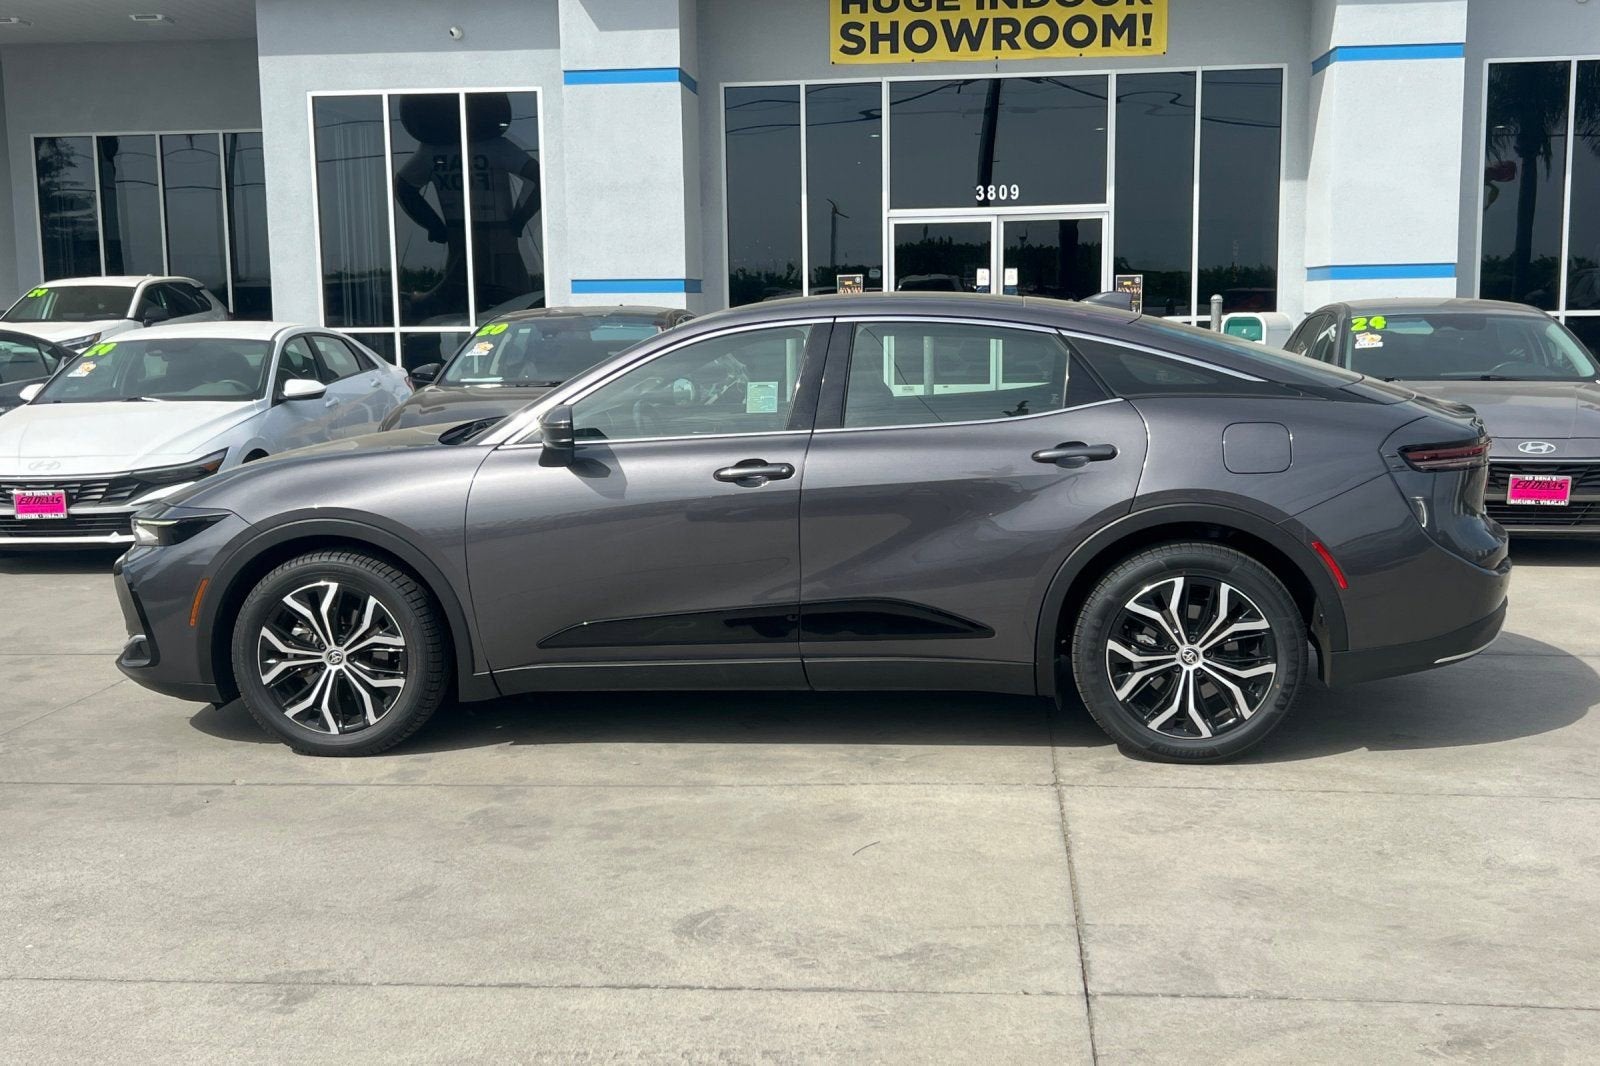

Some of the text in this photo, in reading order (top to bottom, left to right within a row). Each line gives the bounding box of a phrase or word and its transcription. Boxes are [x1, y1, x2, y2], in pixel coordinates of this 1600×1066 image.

[839, 13, 1153, 56] SHOWROOM!
[975, 184, 1020, 201] 3809
[1351, 316, 1387, 331] 24
